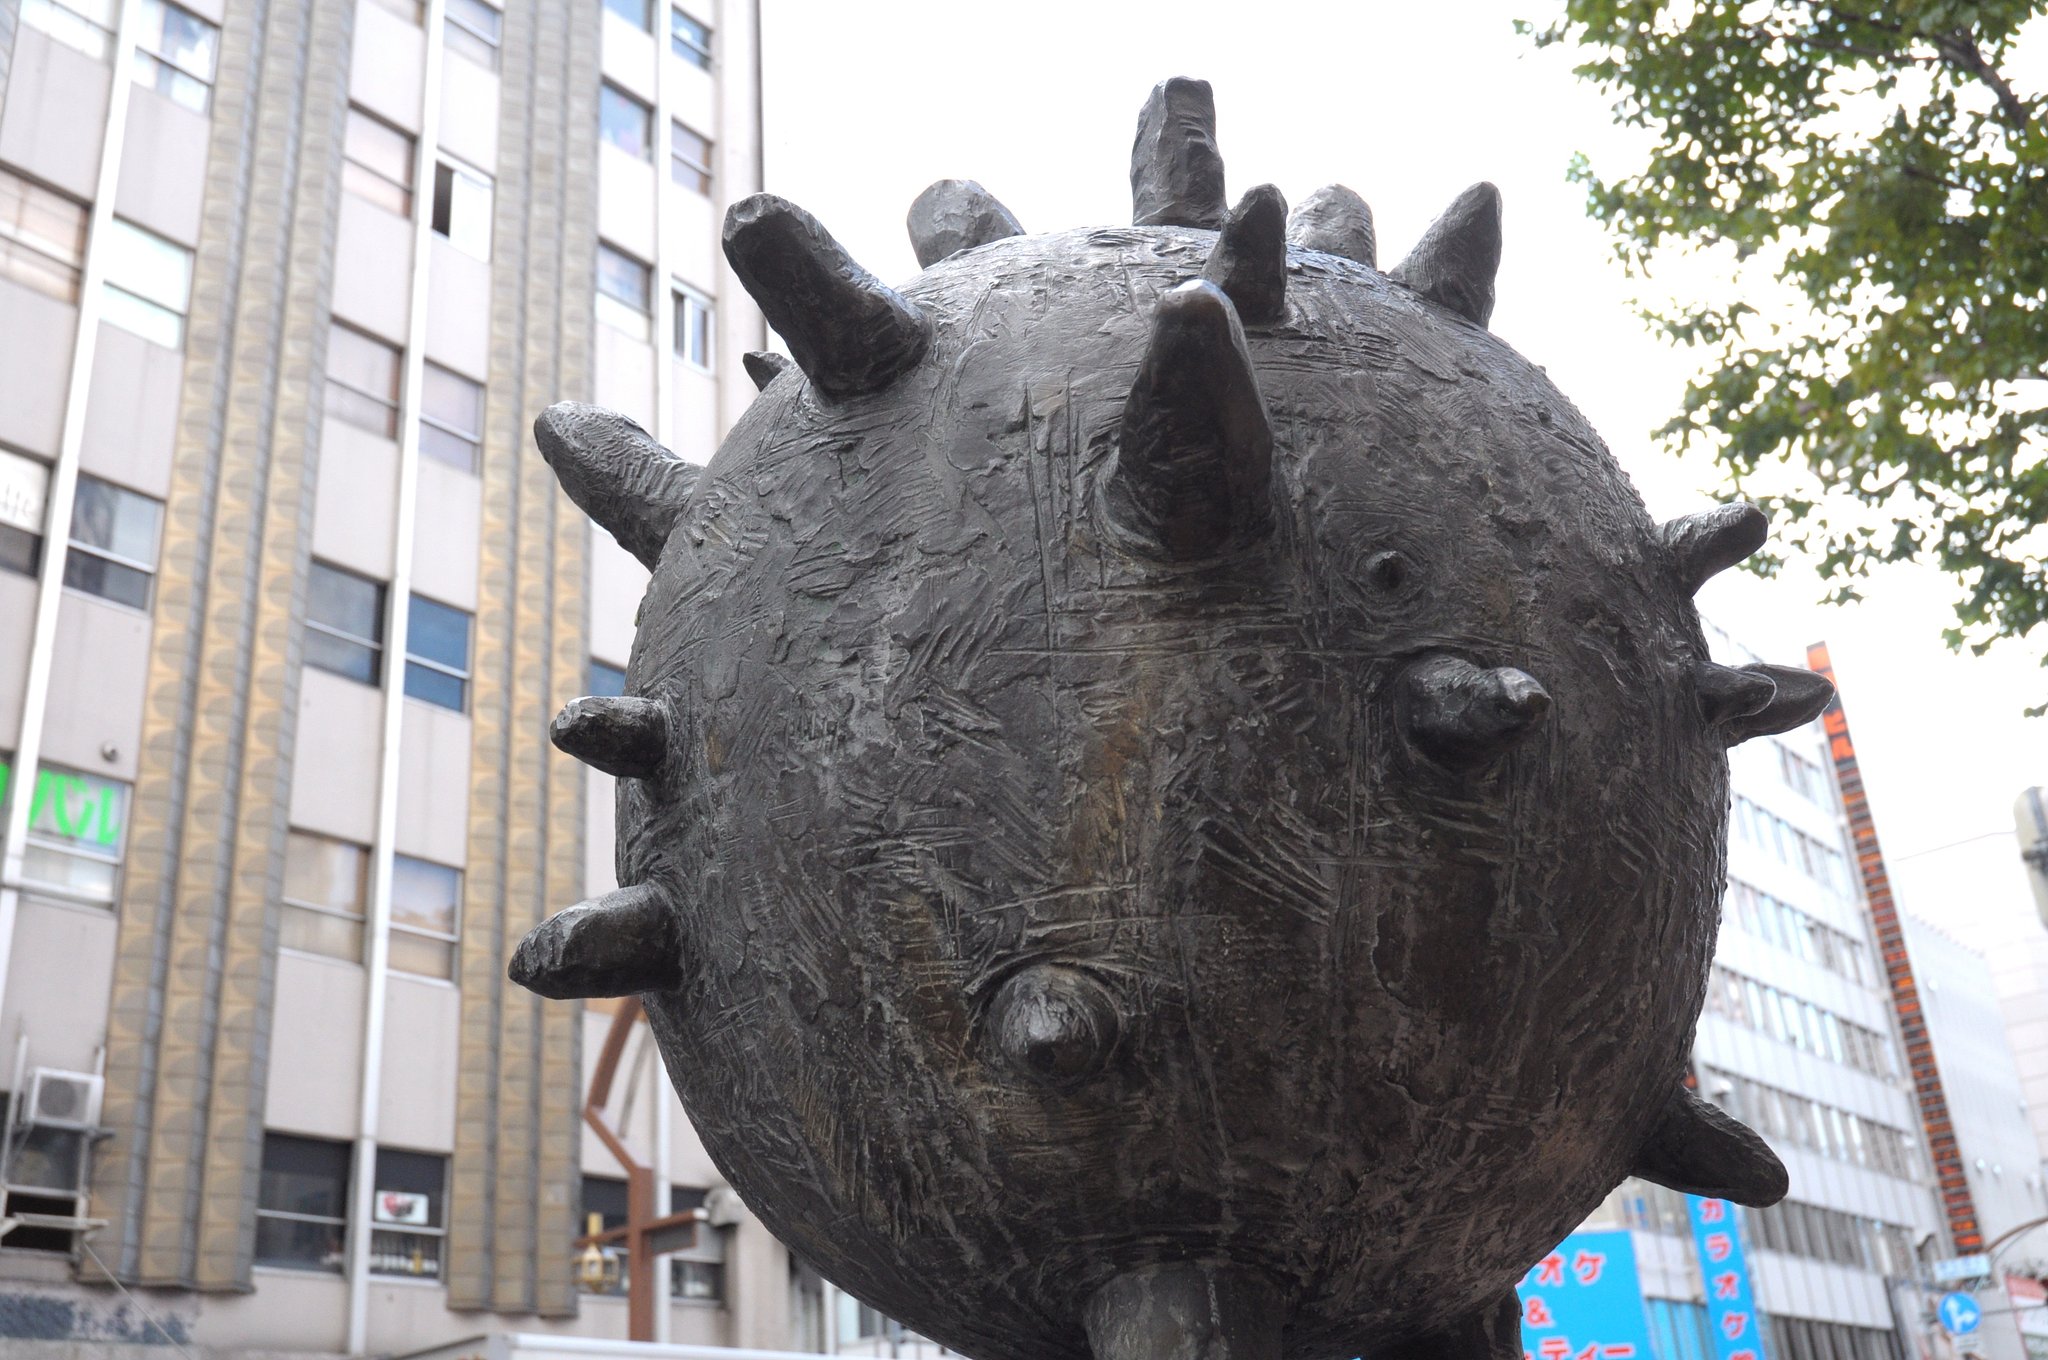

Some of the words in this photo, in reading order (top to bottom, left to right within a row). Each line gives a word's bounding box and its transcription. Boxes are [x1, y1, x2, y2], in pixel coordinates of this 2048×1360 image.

[1516, 1250, 1605, 1287] オケ
[1525, 1296, 1555, 1327] &
[1523, 1336, 1635, 1360] ティー
